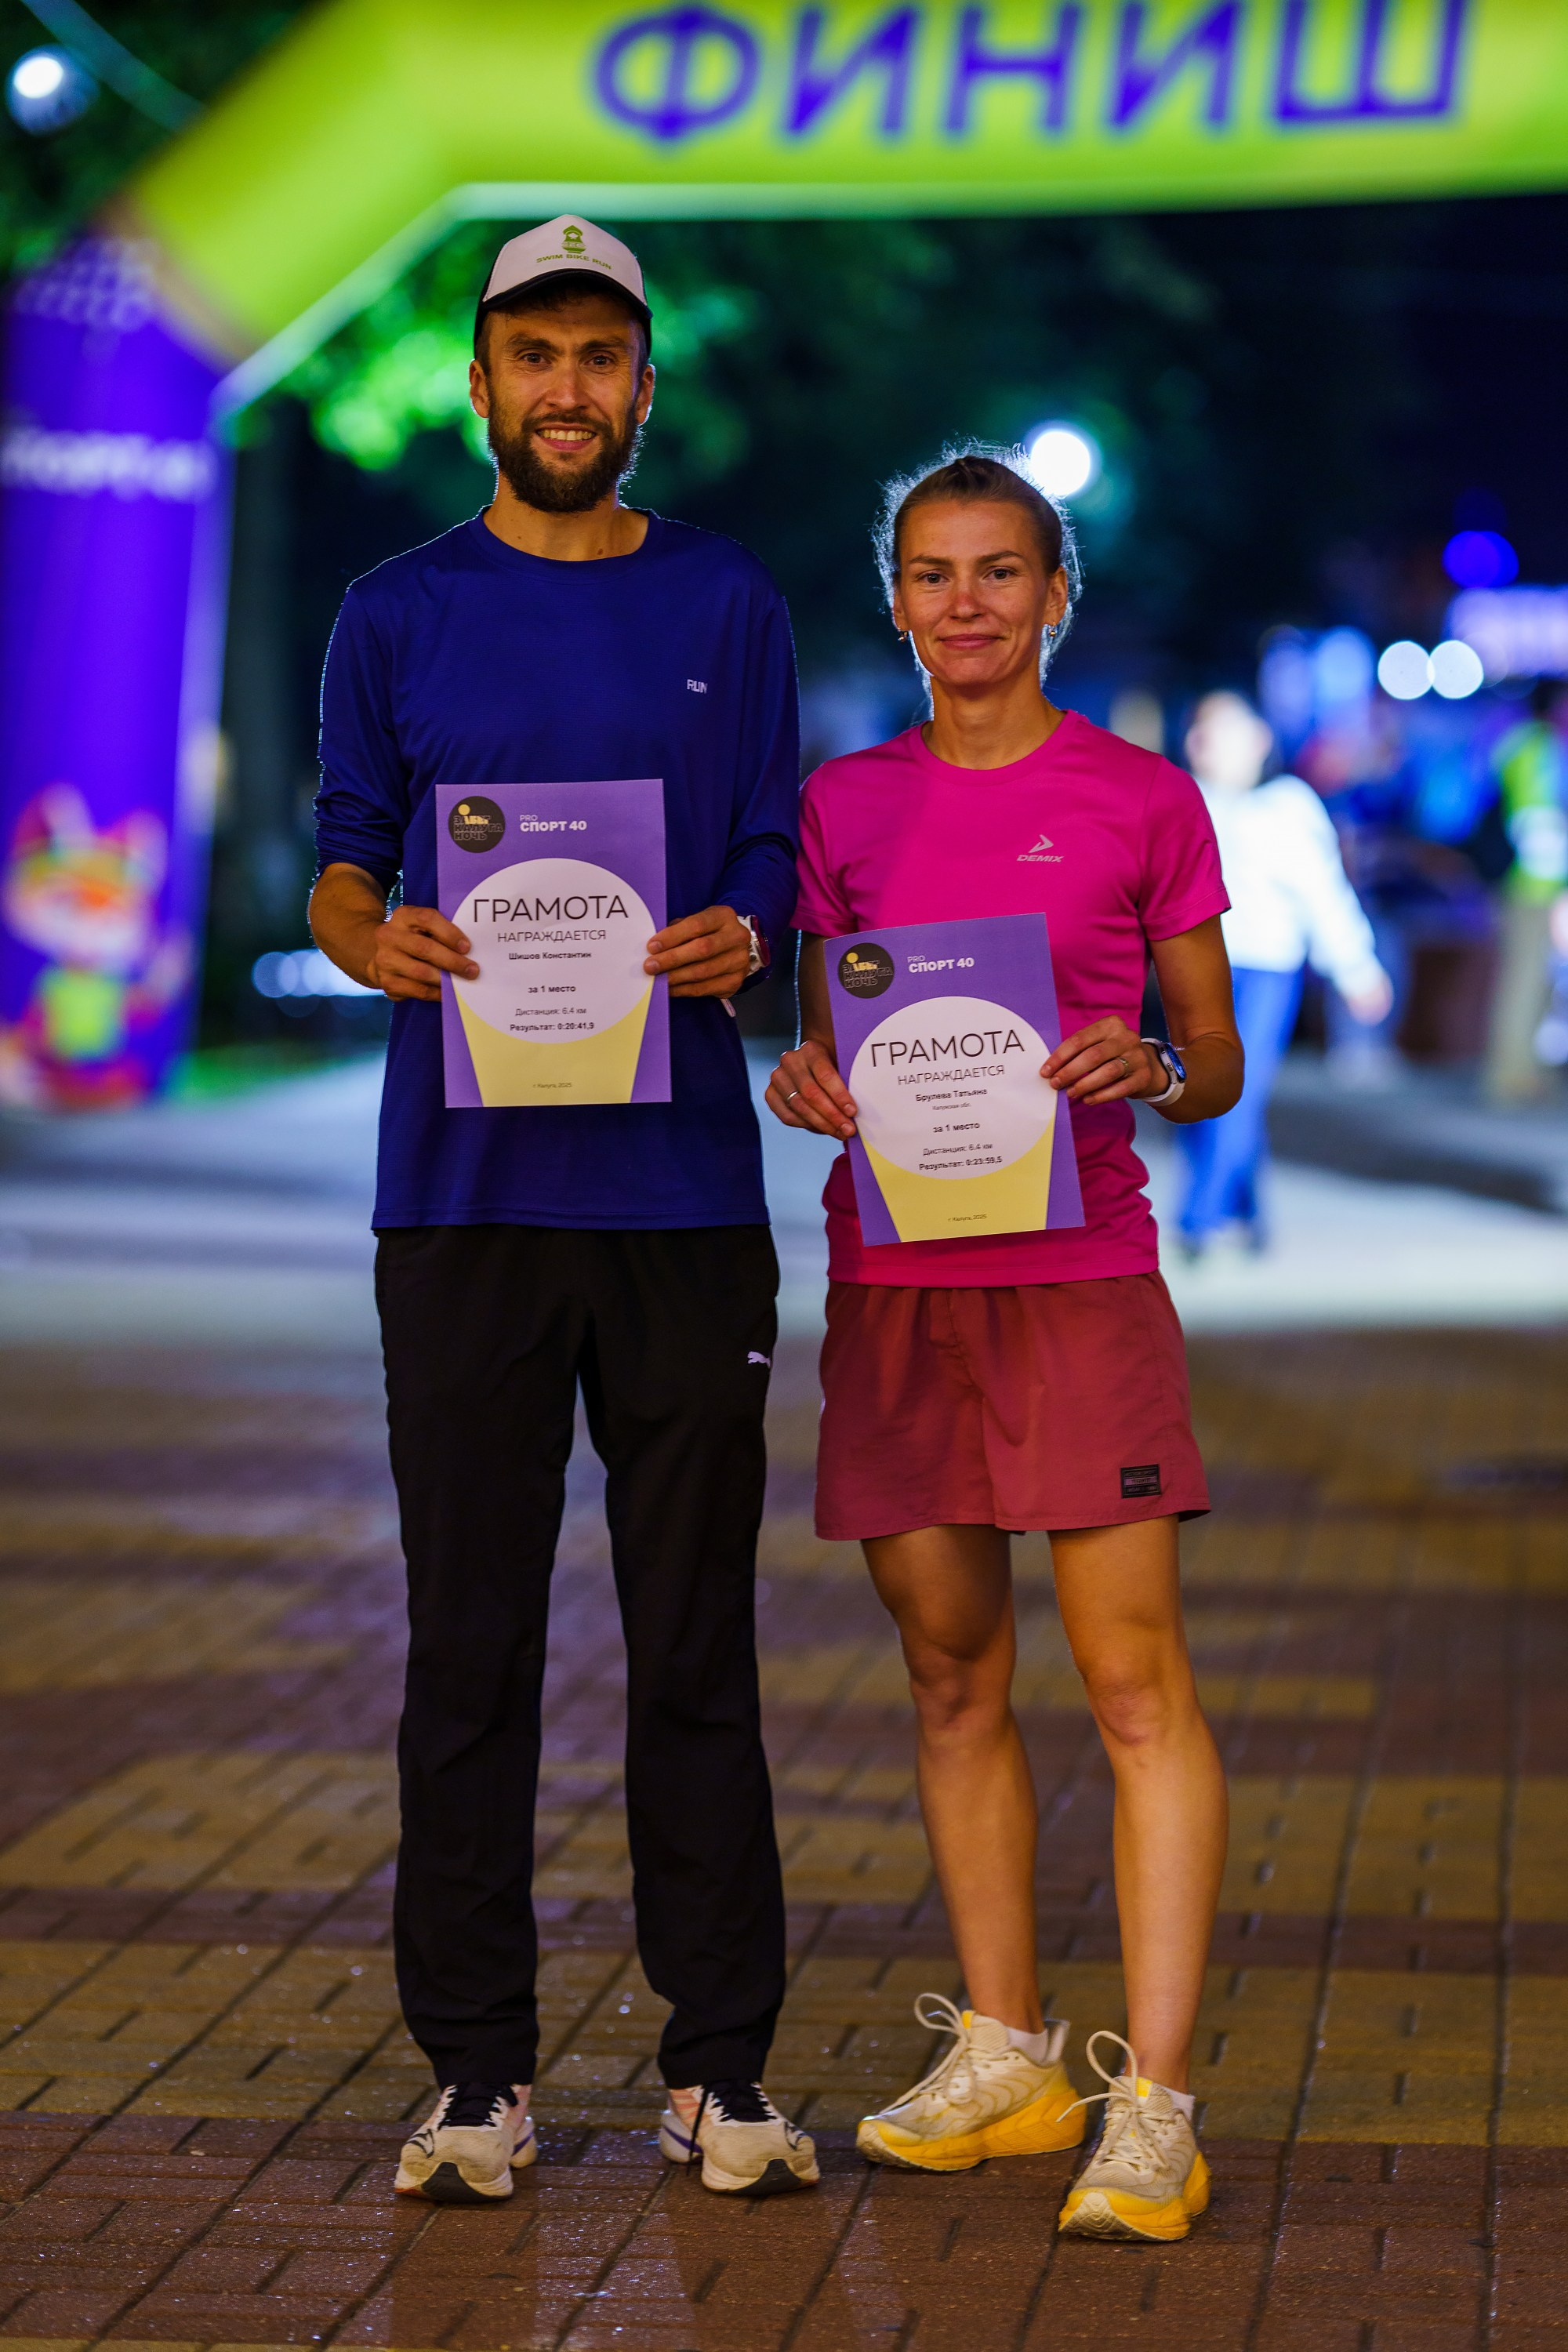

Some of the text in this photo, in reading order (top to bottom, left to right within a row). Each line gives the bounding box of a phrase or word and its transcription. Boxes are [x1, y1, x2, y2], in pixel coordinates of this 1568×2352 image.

[590, 0, 1468, 147] ФИНИШ
[536, 254, 563, 263] SWIM
[592, 258, 612, 270] RUN
[687, 679, 708, 694] RUN
[453, 823, 503, 833] КАЛУГА
[520, 820, 587, 832] СПОРТ 40
[453, 831, 487, 840] НОЧЬ
[474, 895, 629, 923] ГРАМОТА
[497, 930, 606, 943] НАГРАЖДАЕТСЯ
[909, 957, 975, 974] СПОРТ 40
[843, 967, 894, 980] КАЛУГА
[844, 978, 878, 989] НОЧЬ
[510, 1023, 555, 1033] Результат:
[871, 1029, 1025, 1067] ГРАМОТА
[897, 1065, 1005, 1086] НАГРАЖДАЕТСЯ
[953, 1089, 988, 1098] Татьяна
[953, 1123, 980, 1131] место
[919, 1161, 965, 1171] Результат:
